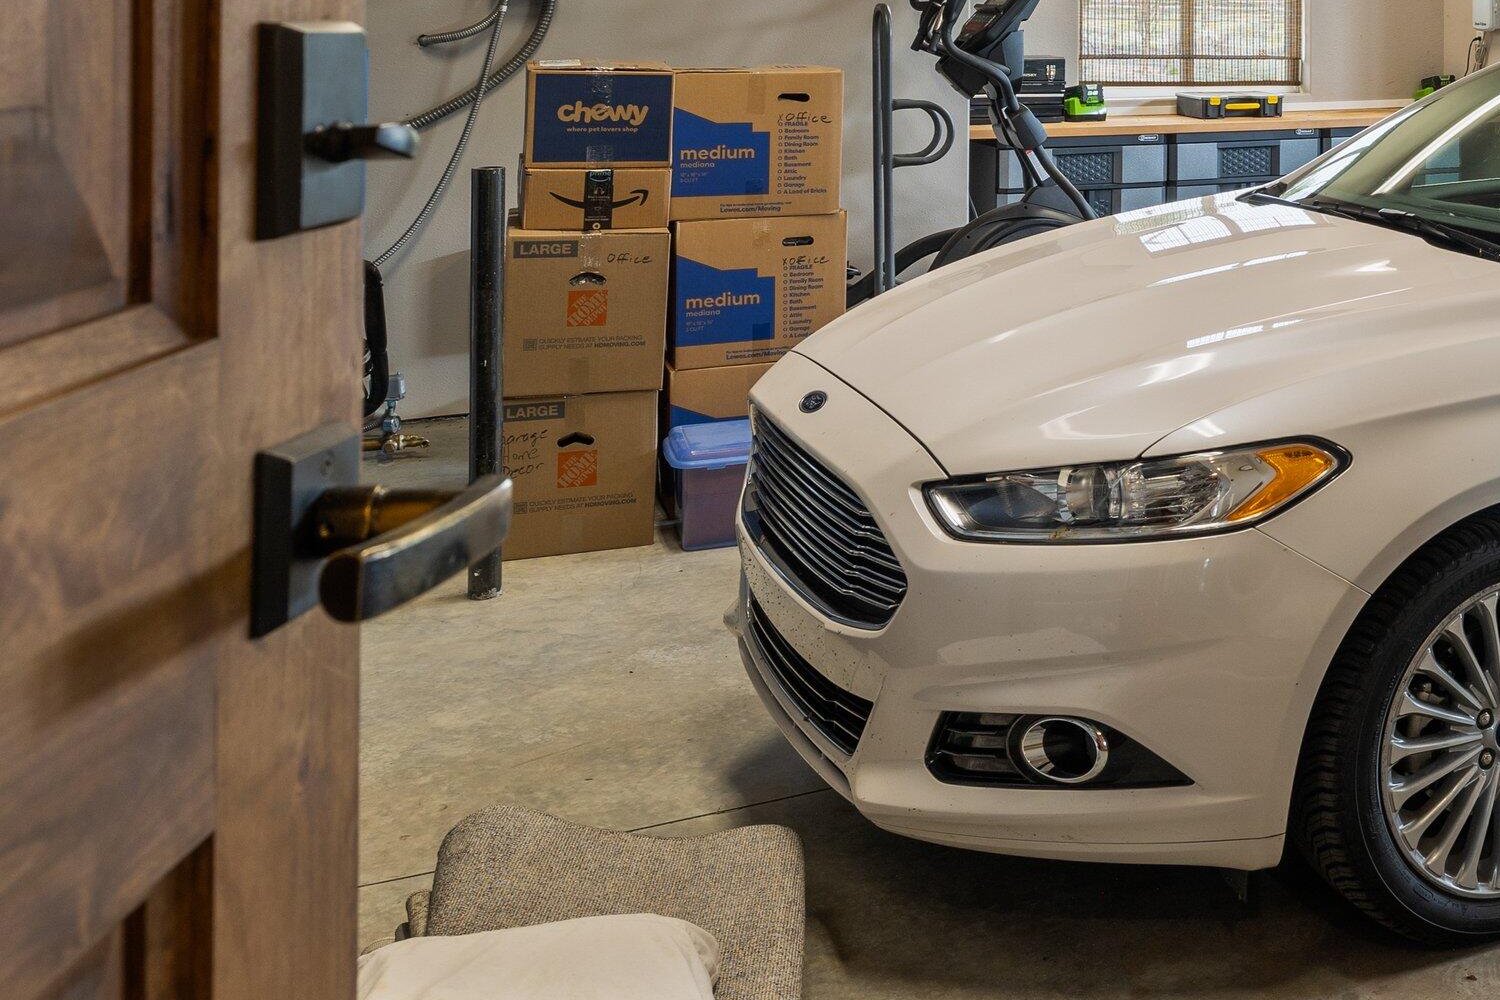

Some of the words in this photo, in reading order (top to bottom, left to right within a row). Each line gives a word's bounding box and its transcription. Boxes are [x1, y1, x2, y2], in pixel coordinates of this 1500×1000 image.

[556, 100, 649, 126] chewy
[785, 112, 832, 124] Office
[680, 144, 756, 160] medium
[519, 243, 572, 255] LARGE
[607, 252, 652, 264] Office
[686, 292, 760, 309] medium
[686, 309, 720, 317] mediana
[506, 404, 559, 419] LARGE
